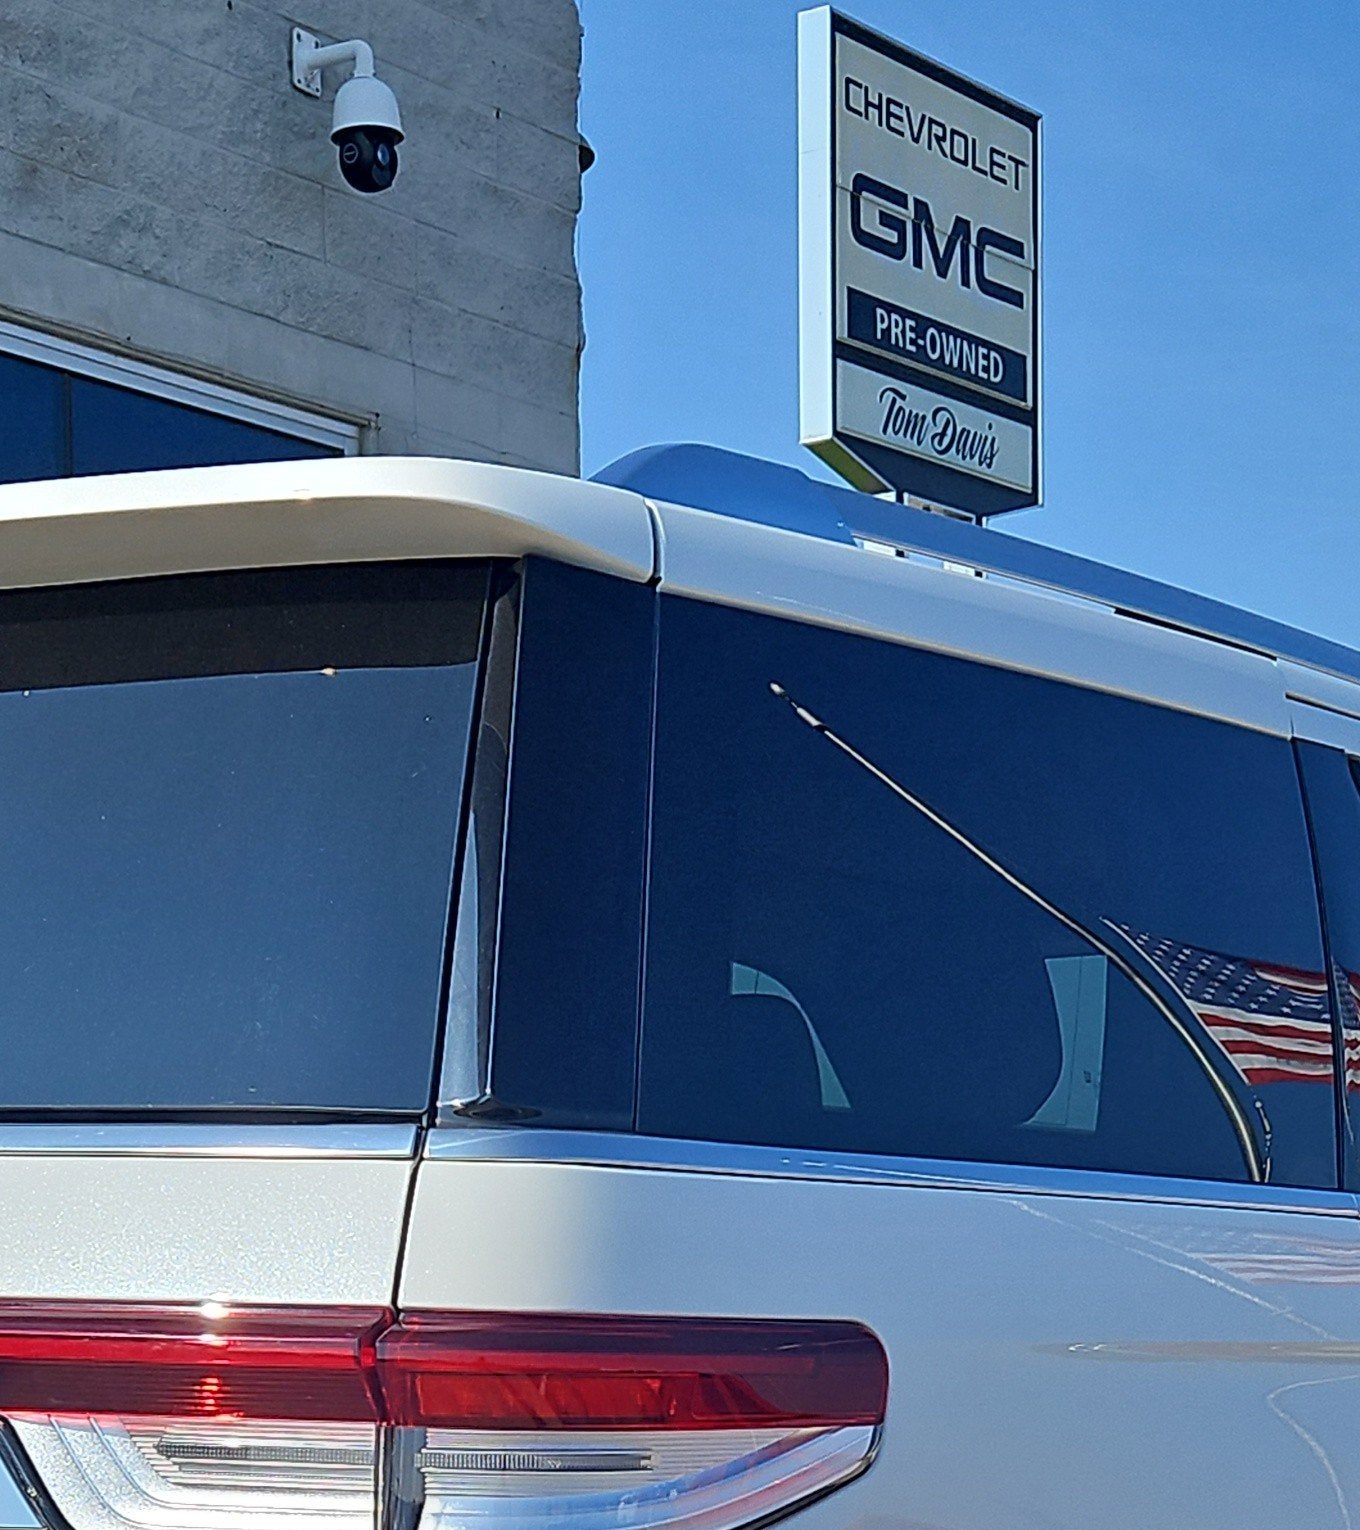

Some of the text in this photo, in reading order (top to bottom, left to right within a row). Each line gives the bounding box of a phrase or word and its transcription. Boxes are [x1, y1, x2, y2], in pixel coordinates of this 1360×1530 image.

[845, 77, 1029, 191] CHEVROLET
[850, 173, 1025, 310] GMC
[875, 307, 1004, 384] PRE-OWNED
[879, 387, 999, 469] Tom Davis
